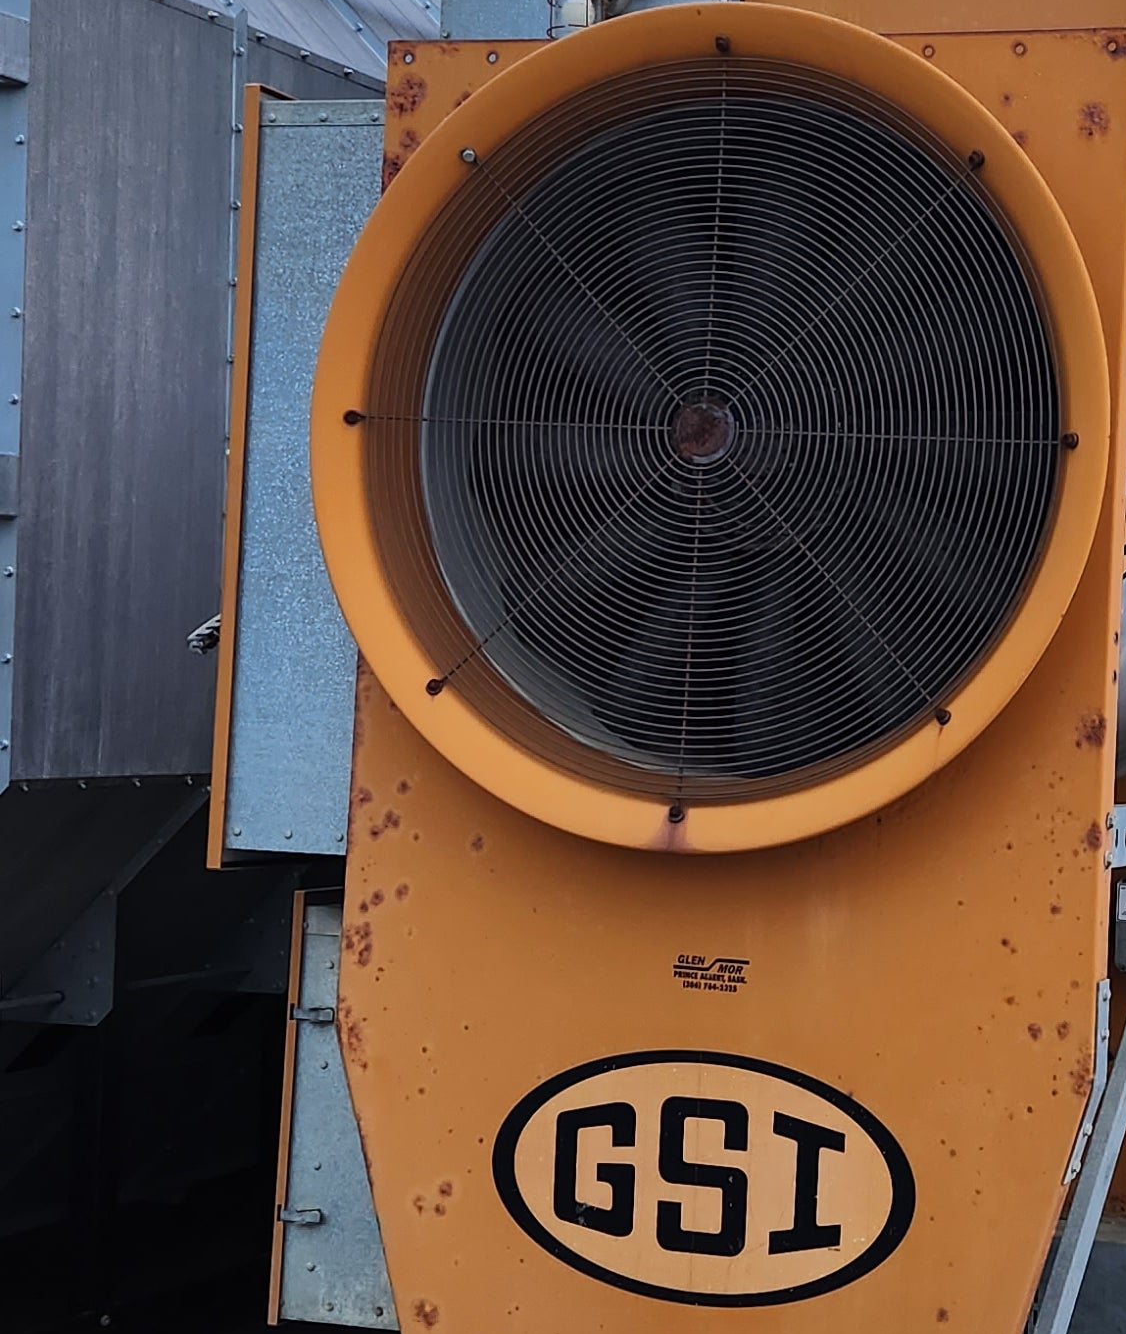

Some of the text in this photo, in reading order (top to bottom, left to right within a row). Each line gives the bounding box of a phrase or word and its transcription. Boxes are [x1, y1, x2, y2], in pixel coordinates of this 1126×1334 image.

[677, 954, 706, 966] GLEN
[717, 963, 744, 975] MOR
[553, 1095, 846, 1257] GSI
